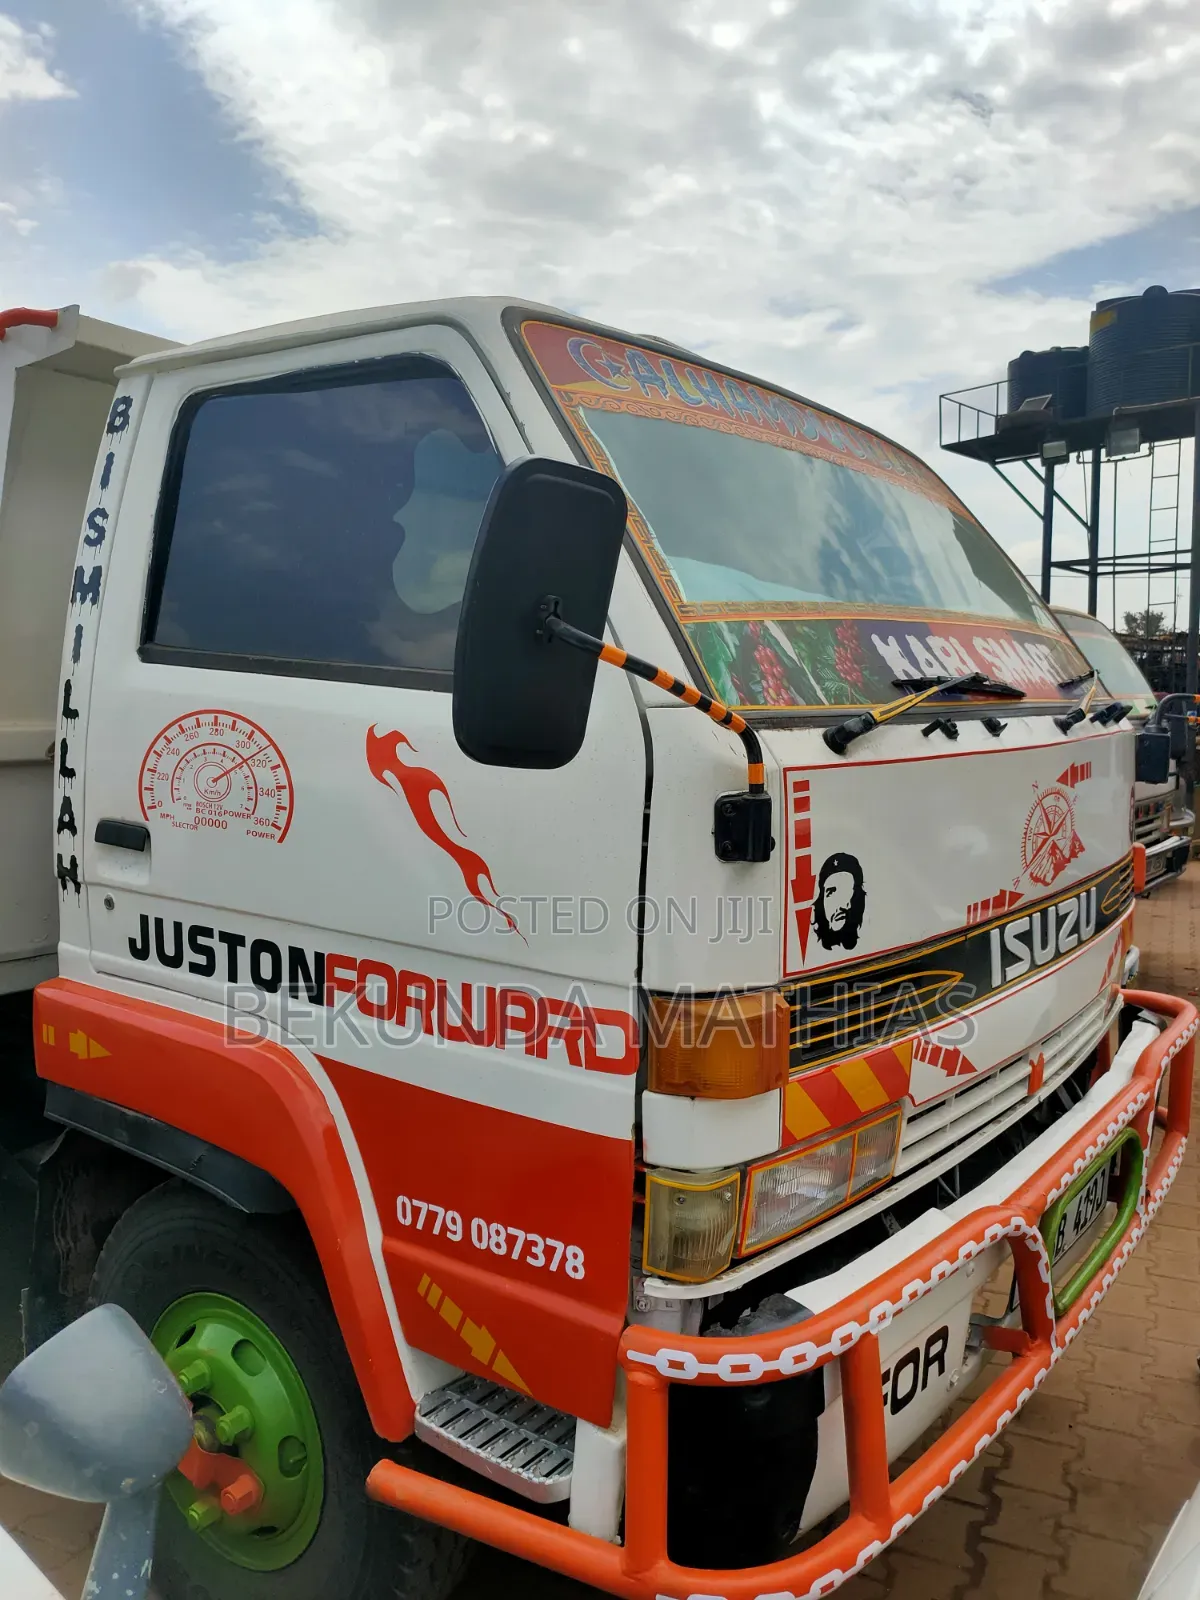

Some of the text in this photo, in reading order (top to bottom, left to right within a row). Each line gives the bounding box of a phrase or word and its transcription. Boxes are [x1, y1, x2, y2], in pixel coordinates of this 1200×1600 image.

[57, 395, 133, 903] BISMILLAH
[184, 731, 199, 742] 260
[209, 728, 224, 737] 280
[235, 740, 250, 749] 300
[166, 747, 180, 756] 240
[251, 759, 267, 768] 320
[157, 773, 169, 781] 220
[259, 788, 276, 798] 340
[196, 801, 213, 810] BOSCH
[160, 812, 175, 820] MPH
[208, 809, 223, 817] 016
[223, 810, 252, 820] POWER
[194, 816, 228, 829] 00000
[253, 817, 270, 827] 360
[246, 829, 276, 840] POWER
[990, 887, 1097, 988] ISUZU
[396, 1195, 585, 1280] 0779 087378
